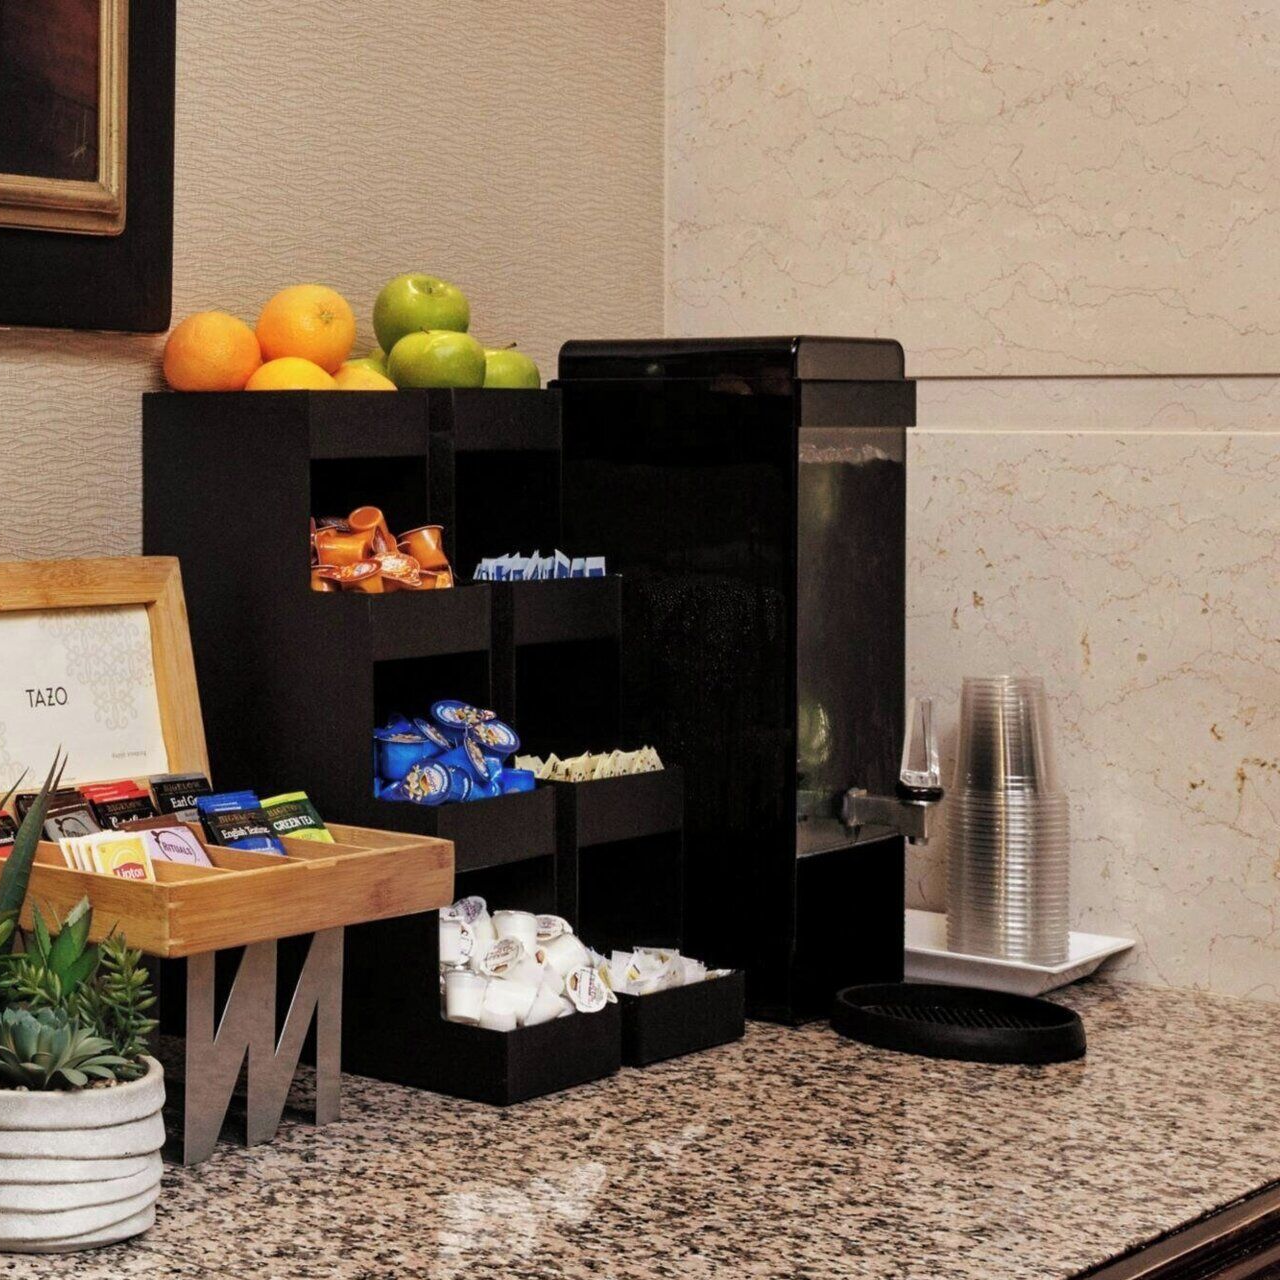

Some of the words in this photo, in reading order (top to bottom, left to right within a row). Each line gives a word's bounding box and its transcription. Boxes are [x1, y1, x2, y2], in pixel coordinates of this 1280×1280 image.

[25, 686, 68, 708] TAZO
[170, 796, 188, 808] Earl
[273, 817, 300, 831] GREEN
[299, 815, 315, 826] TEA
[221, 826, 246, 840] English
[162, 841, 193, 856] RITUALS
[116, 867, 145, 879] Lipton
